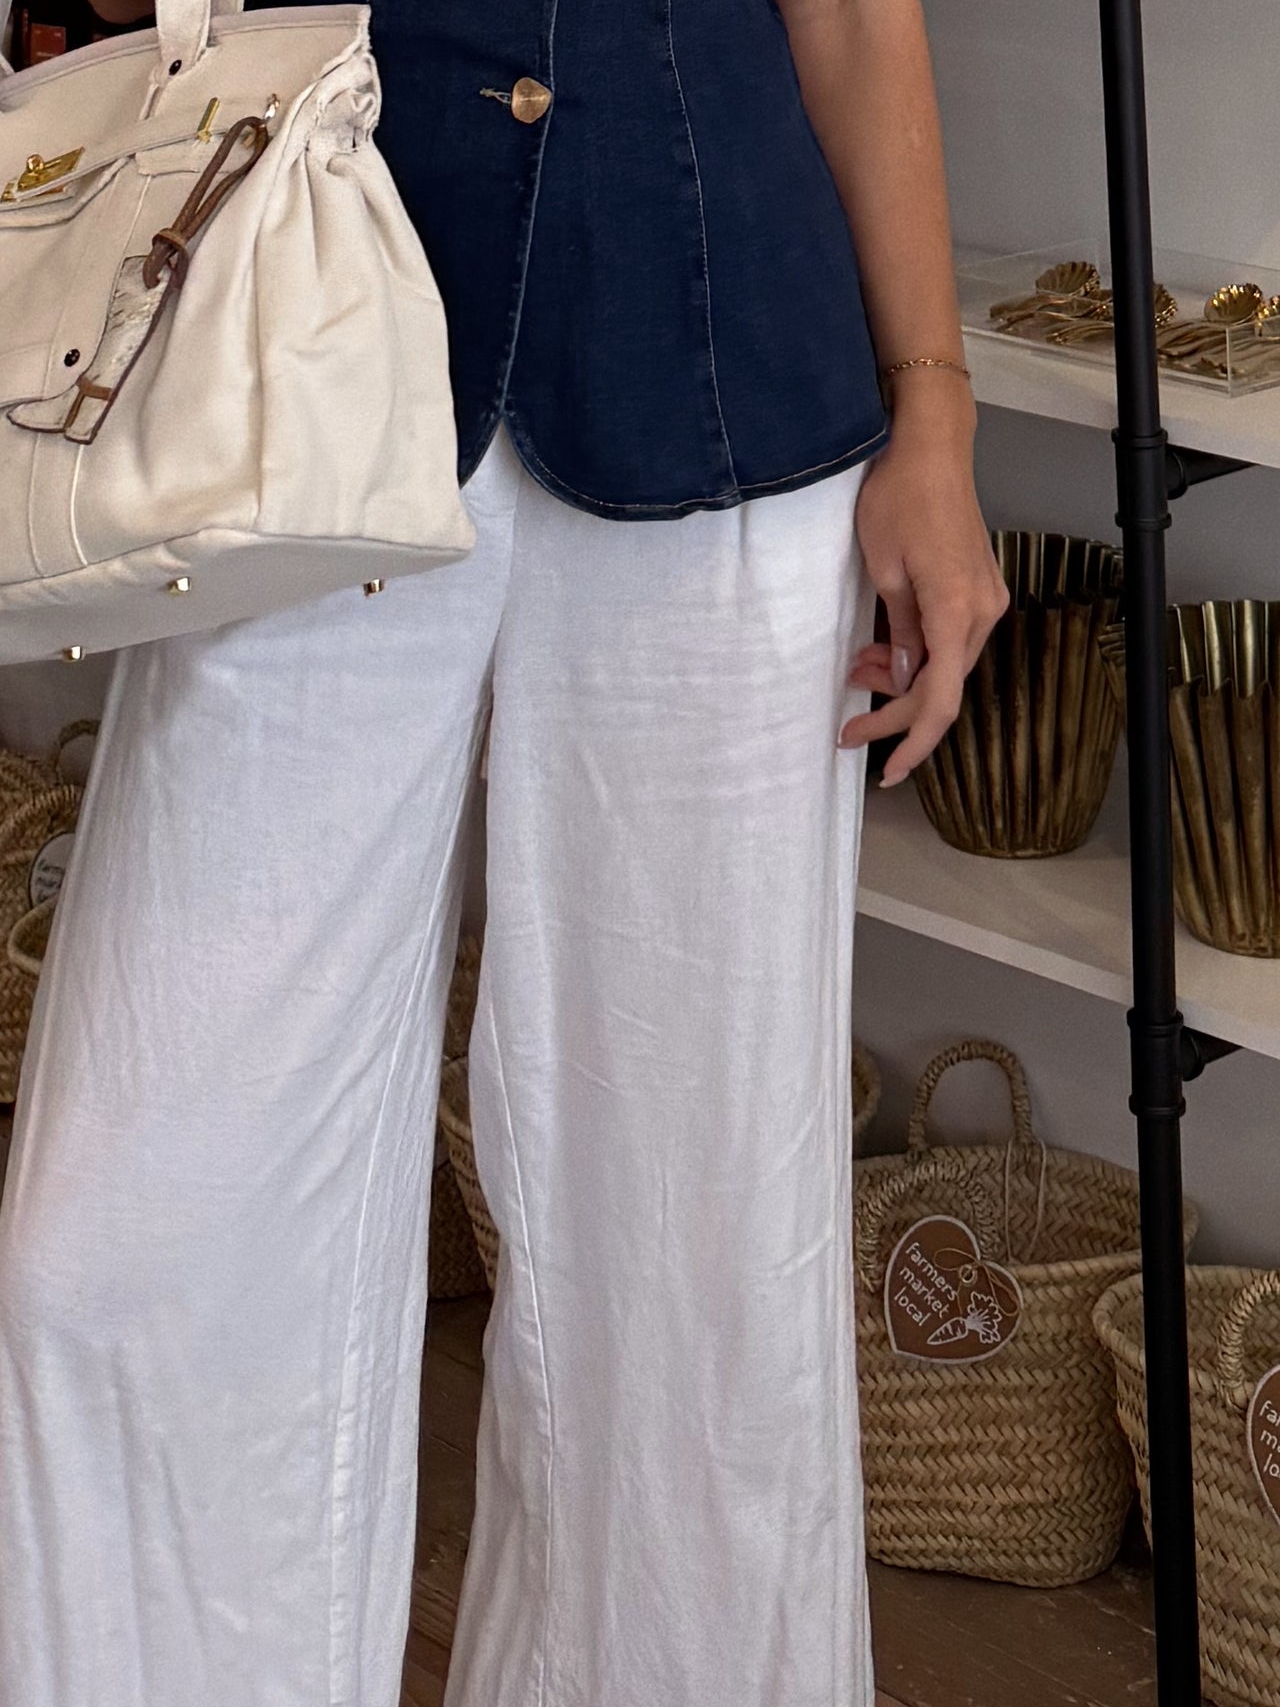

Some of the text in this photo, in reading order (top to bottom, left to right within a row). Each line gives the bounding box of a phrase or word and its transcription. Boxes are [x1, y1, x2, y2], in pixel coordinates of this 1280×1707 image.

[899, 1266, 950, 1319] market
[905, 1241, 959, 1302] farmers
[893, 1286, 932, 1327] local
